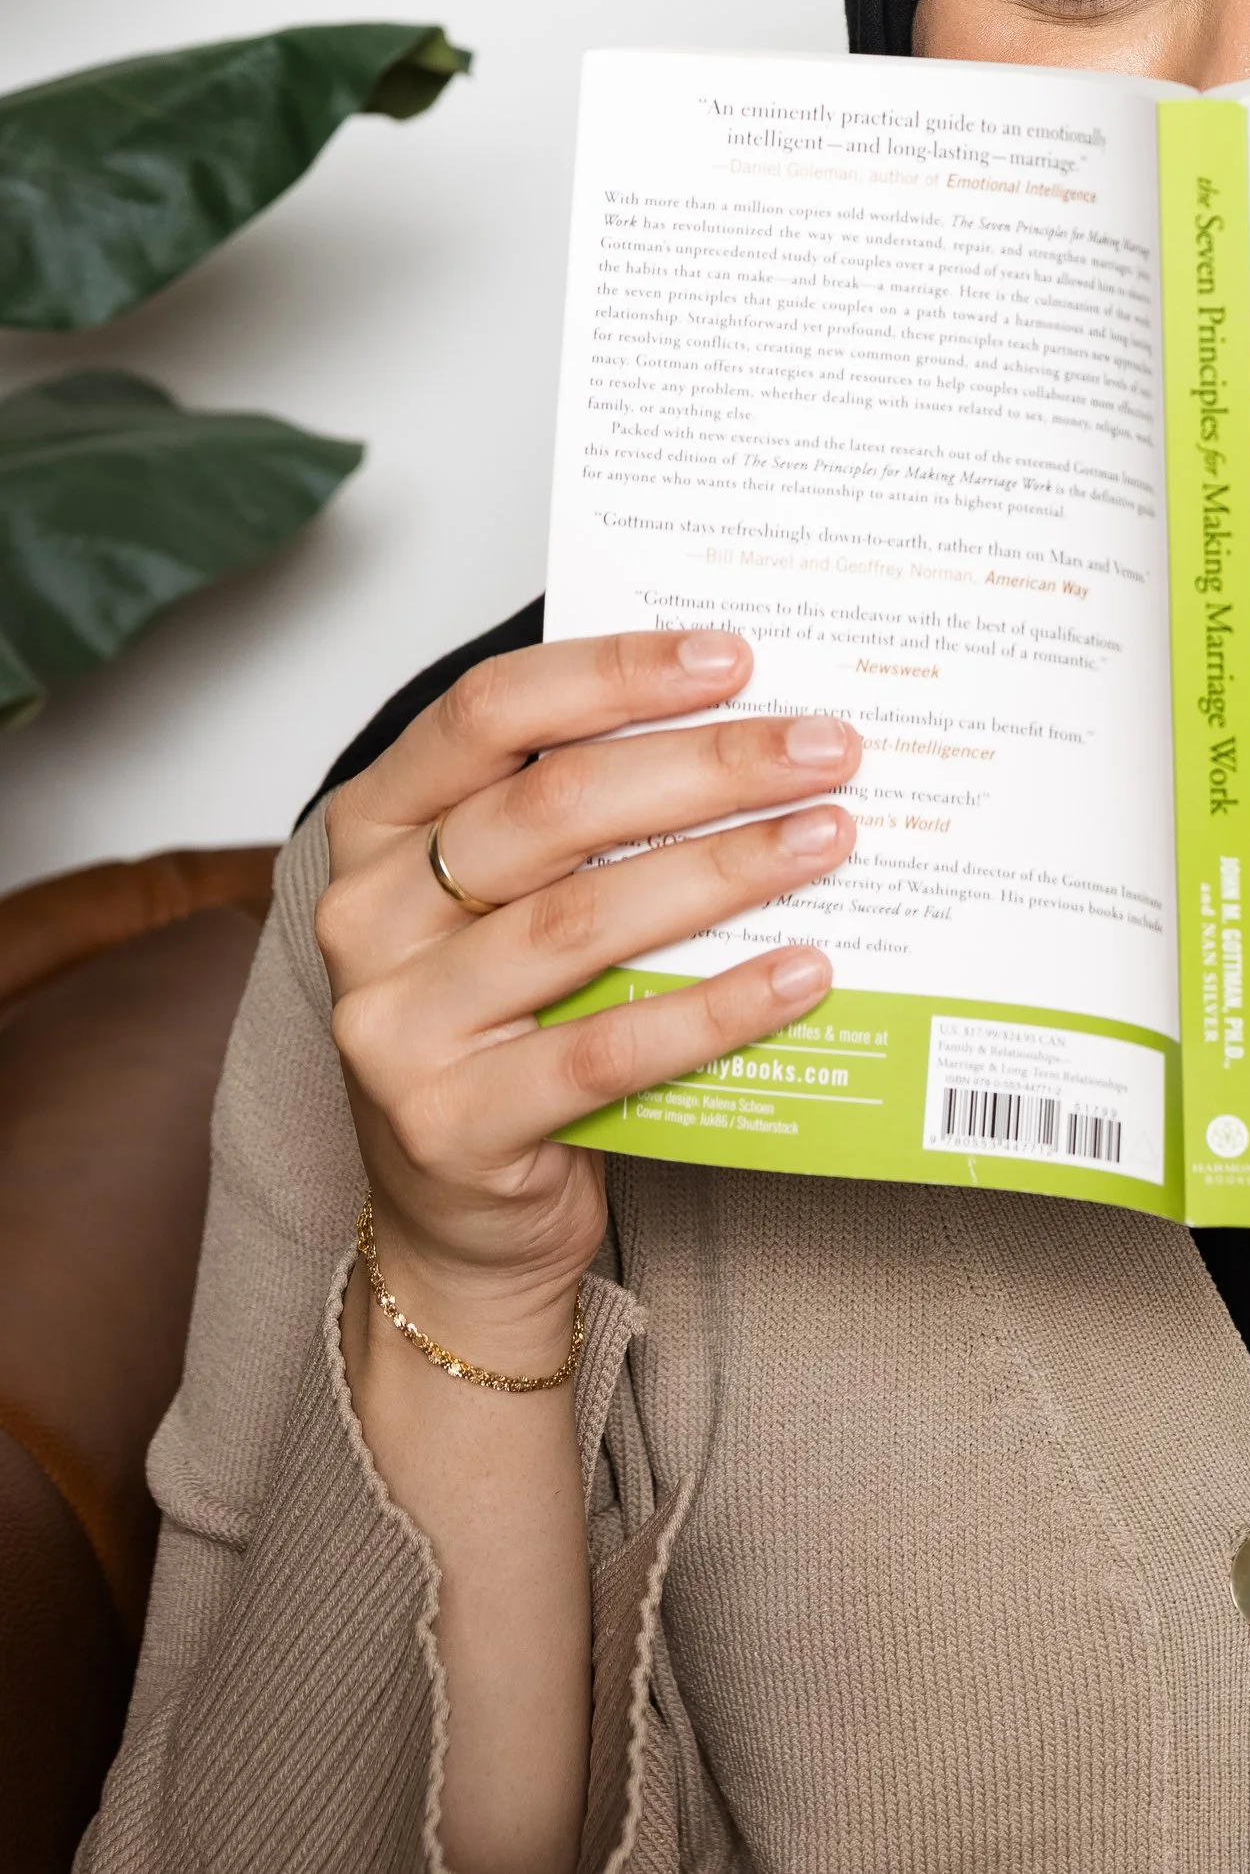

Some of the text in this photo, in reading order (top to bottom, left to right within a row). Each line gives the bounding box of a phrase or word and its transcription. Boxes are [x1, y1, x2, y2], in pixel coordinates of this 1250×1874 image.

[740, 101, 833, 122] eminently
[841, 108, 920, 130] practical
[925, 112, 975, 135] guide
[980, 119, 996, 135] to
[1002, 124, 1021, 137] an
[1025, 124, 1107, 147] emotionally
[869, 169, 919, 185] author
[924, 172, 940, 187] of
[945, 171, 1022, 195] Emotional
[1023, 179, 1098, 206] Intelligence
[583, 441, 1053, 493] this revised edition of The Seven Principles for Making Marriage Work
[581, 463, 603, 480] for
[606, 471, 657, 486] anyone
[661, 470, 691, 486] who
[696, 477, 737, 490] wants
[741, 475, 775, 492] their
[780, 479, 865, 503] relationship
[869, 489, 884, 500] to
[887, 491, 929, 503] attain
[933, 493, 950, 505] its
[953, 492, 1003, 512] highest
[1190, 177, 1240, 817] the Seven Principles for Making Marriage Work
[679, 518, 716, 534] stays
[720, 519, 812, 544] refreshingly
[937, 536, 983, 555] rather
[987, 540, 1021, 560] than
[1025, 550, 1045, 563] on
[1086, 554, 1111, 574] and
[740, 549, 793, 568] Marvel
[799, 557, 830, 571] and
[835, 556, 903, 579] Geoffrey
[983, 570, 1057, 593] American
[1060, 578, 1090, 602] Way
[719, 600, 771, 614] comes
[775, 600, 792, 615] to
[796, 600, 825, 618] this
[829, 604, 903, 624] endeavor
[907, 609, 941, 628] with
[946, 611, 971, 631] the
[975, 614, 1007, 633] best
[1010, 620, 1026, 637] of
[720, 619, 743, 636] the
[750, 622, 791, 642] spirit
[795, 624, 812, 641] of
[816, 630, 825, 642] a
[830, 631, 895, 647] scientist
[899, 632, 930, 650] and
[934, 634, 959, 653] the
[964, 638, 996, 656] soul
[1000, 642, 1016, 659] of
[1019, 648, 1028, 661] a
[858, 706, 953, 731] relationship
[959, 718, 986, 731] can
[991, 715, 1044, 738] benefit
[873, 787, 904, 800] new
[904, 814, 951, 833] World
[1200, 882, 1219, 1043] and NAN SILVER
[787, 1023, 820, 1042] titles
[823, 1025, 834, 1042] &
[839, 1028, 870, 1044] more
[874, 1030, 888, 1046] at
[938, 1041, 989, 1056] Family &
[936, 1057, 985, 1073] Marriage
[988, 1062, 997, 1073] &
[1063, 1071, 1129, 1093] Relationships
